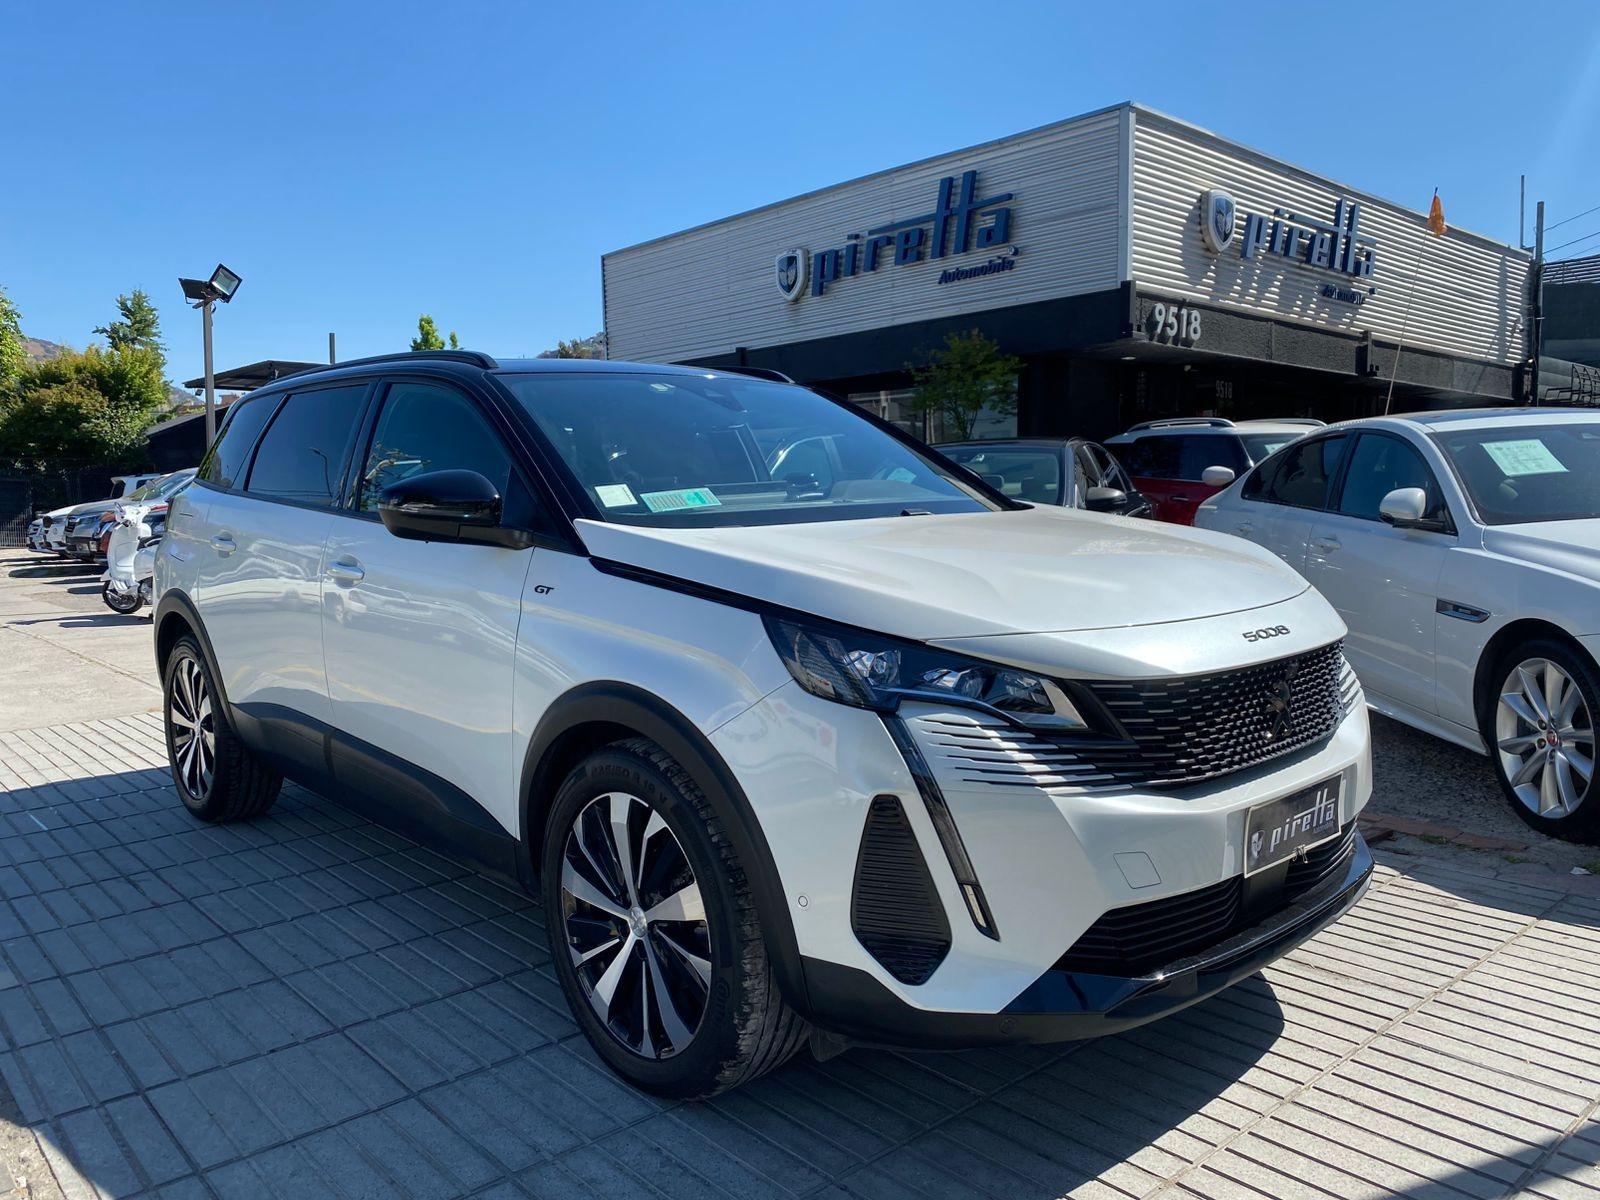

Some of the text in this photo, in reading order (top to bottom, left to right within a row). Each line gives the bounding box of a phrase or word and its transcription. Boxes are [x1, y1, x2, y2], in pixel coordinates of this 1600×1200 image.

[1153, 302, 1202, 341] 9518
[534, 584, 555, 595] GT
[1242, 625, 1290, 642] 5008
